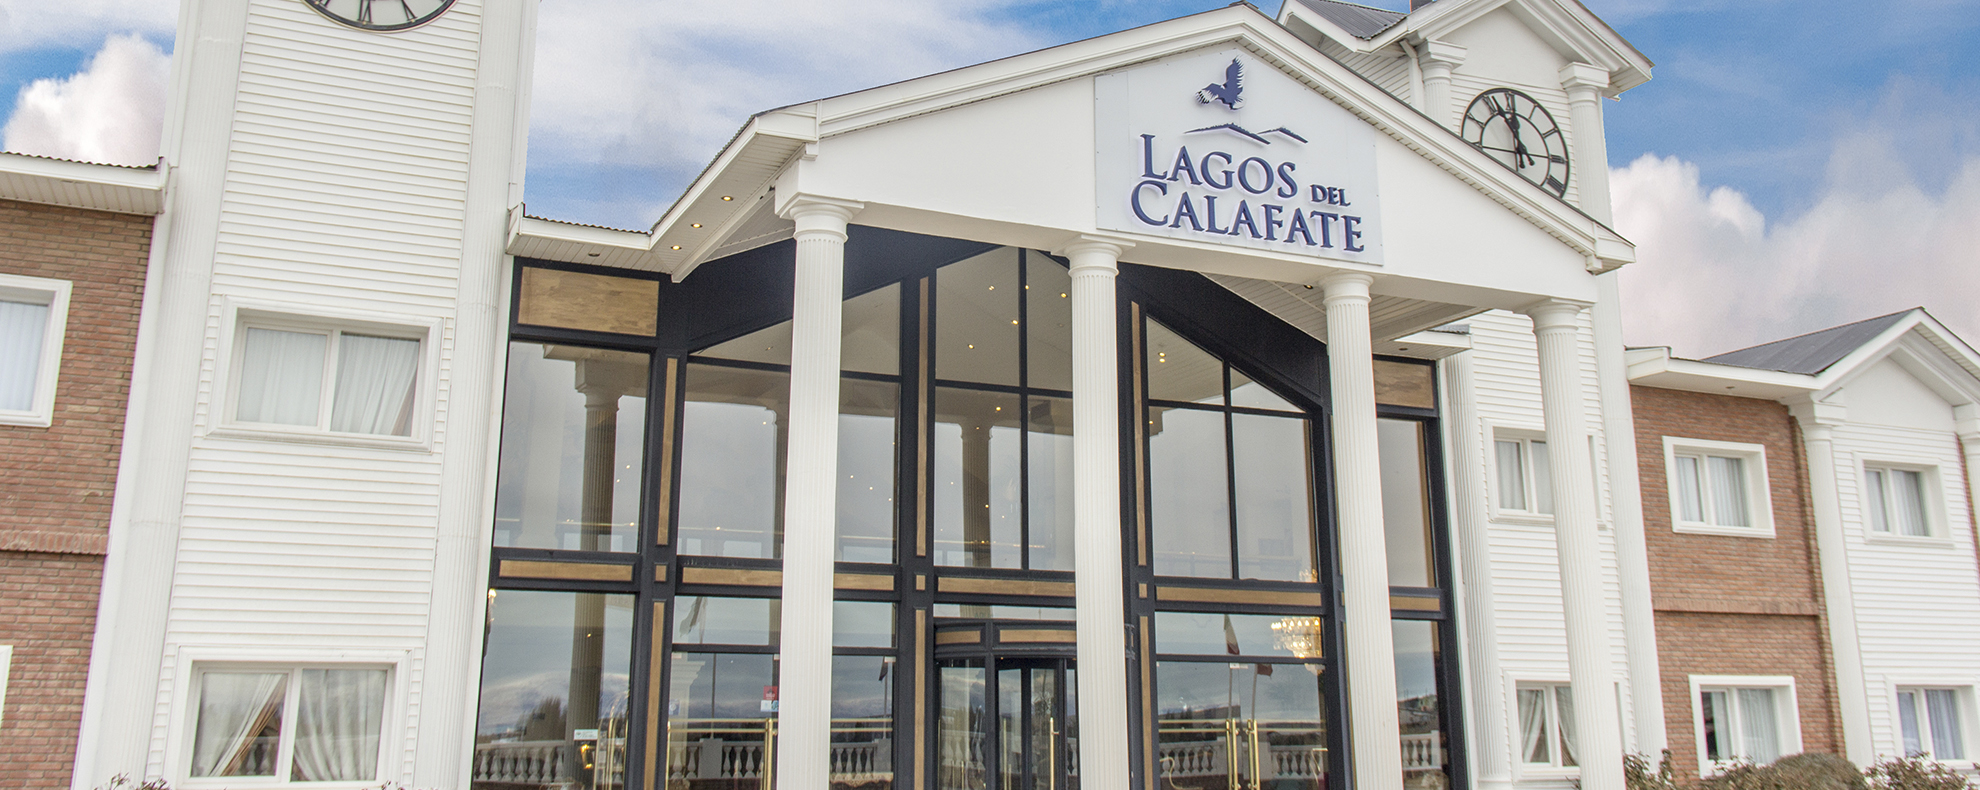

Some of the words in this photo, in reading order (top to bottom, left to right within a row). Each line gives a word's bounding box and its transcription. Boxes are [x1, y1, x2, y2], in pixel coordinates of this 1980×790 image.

[1140, 133, 1298, 199] LAGOS
[1310, 184, 1351, 206] DEL
[1131, 180, 1365, 253] CALAFATE
